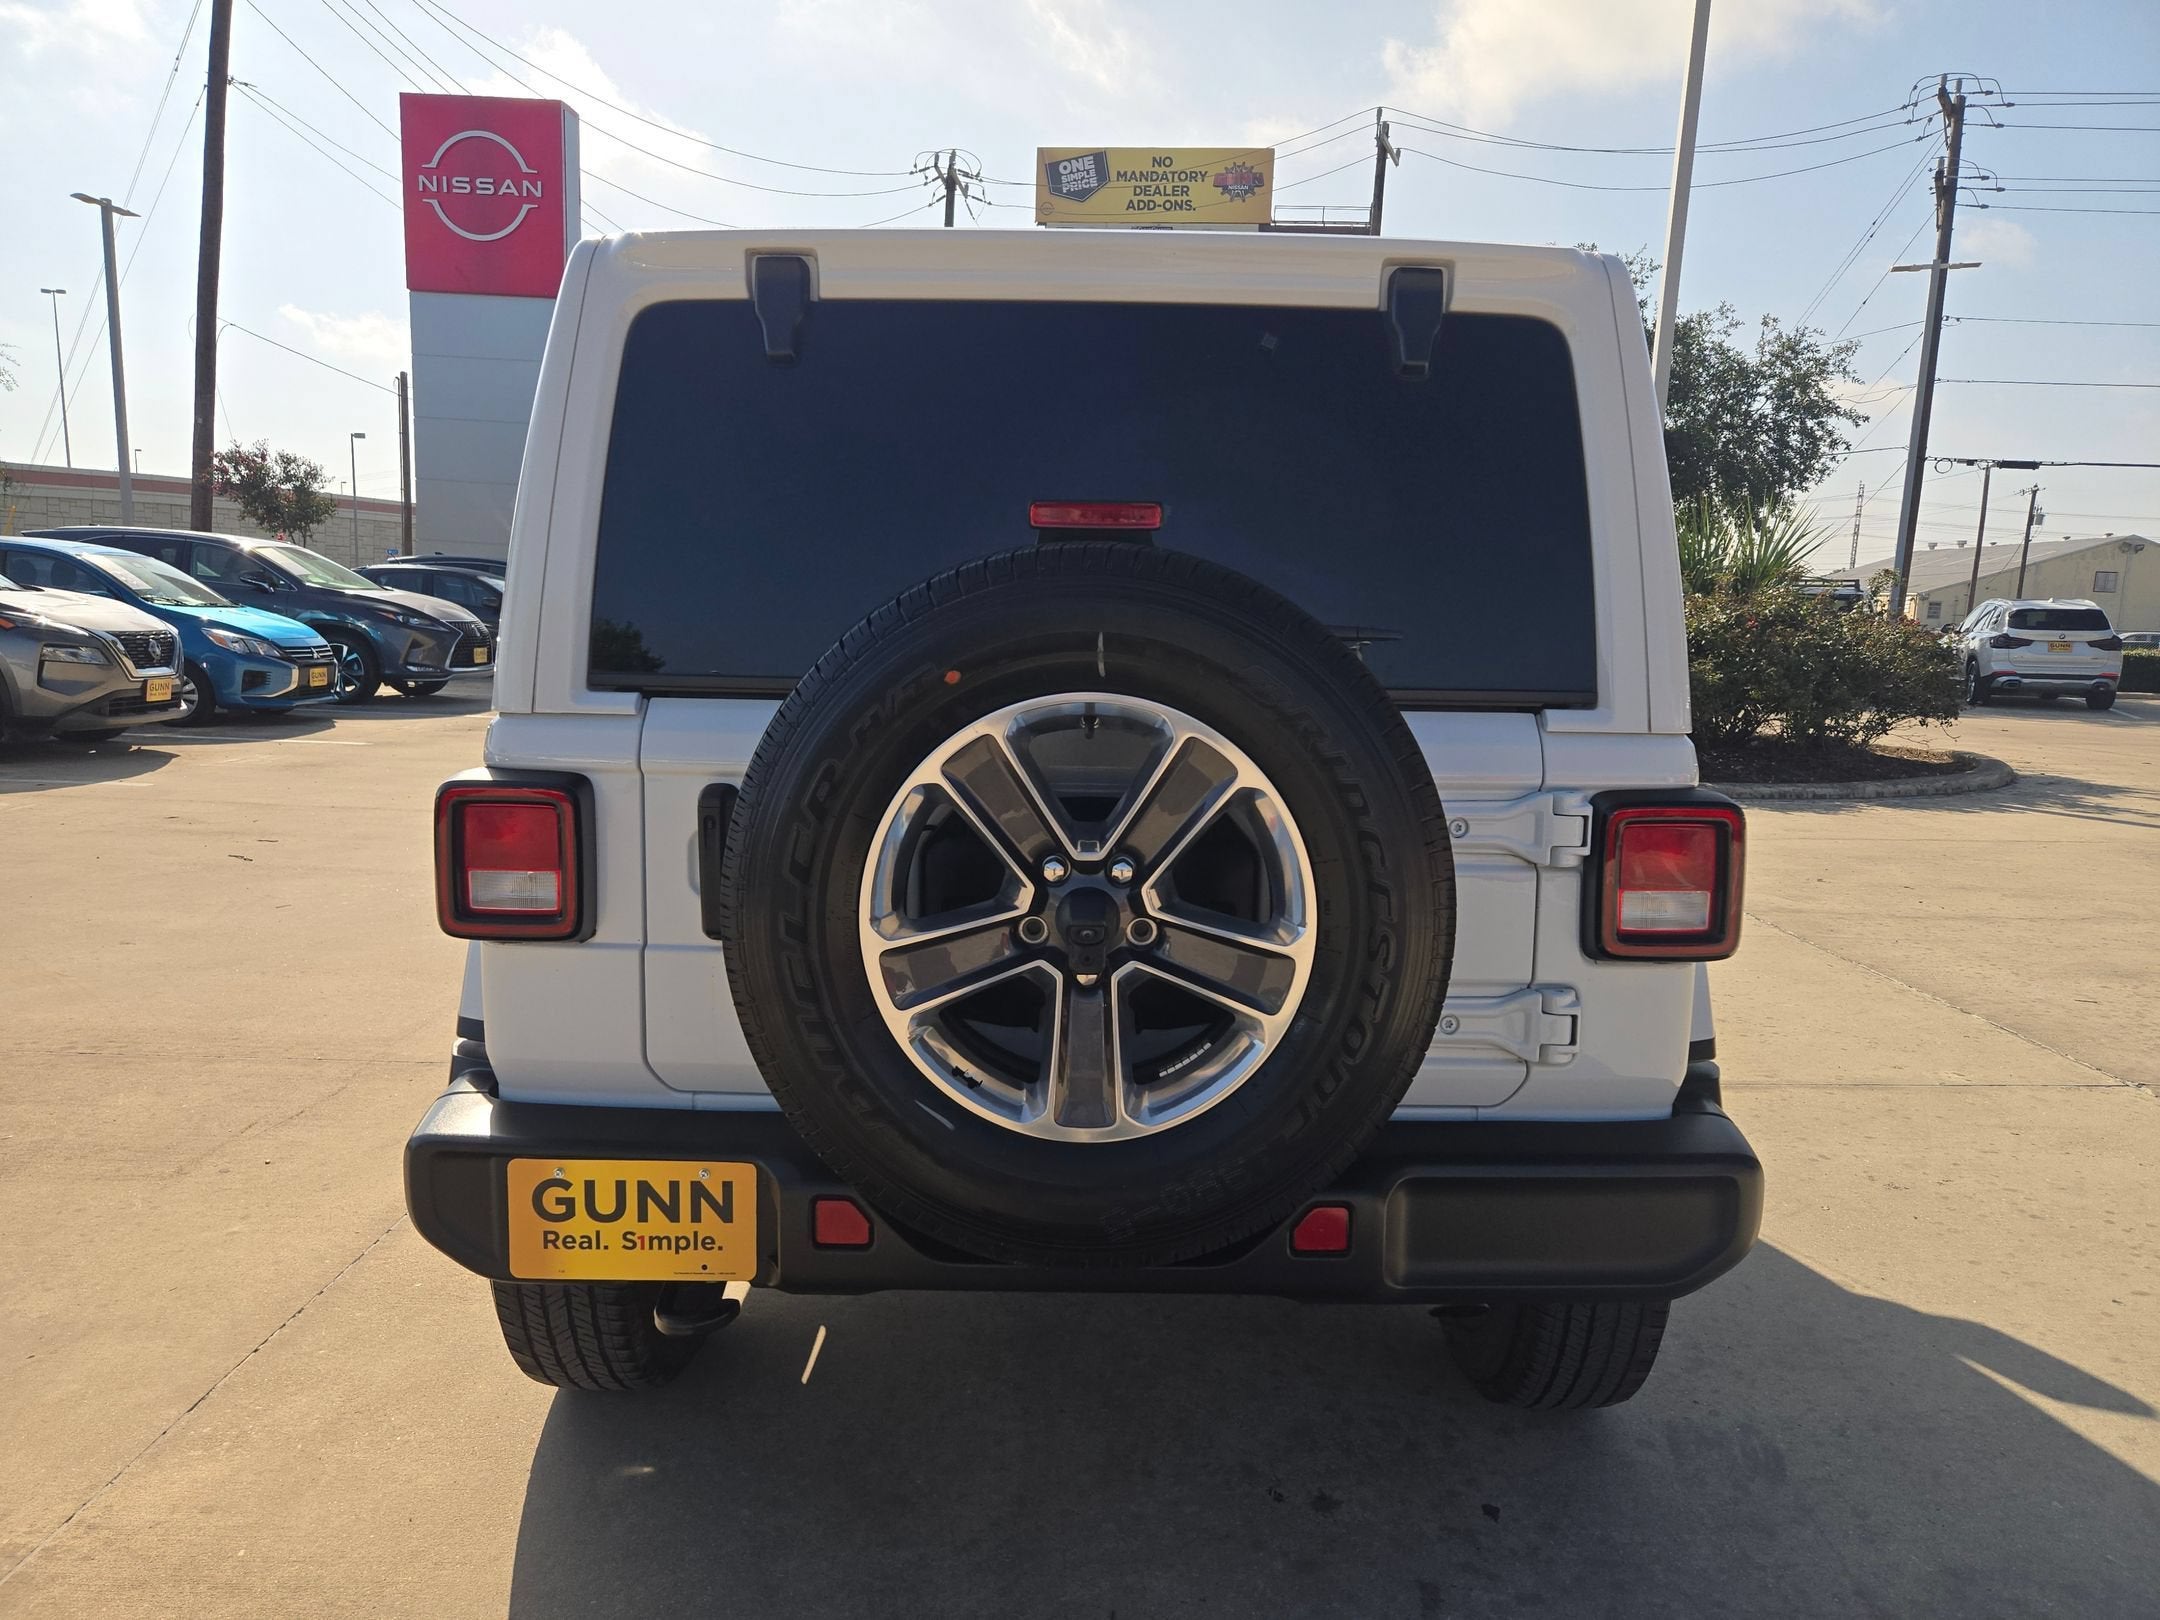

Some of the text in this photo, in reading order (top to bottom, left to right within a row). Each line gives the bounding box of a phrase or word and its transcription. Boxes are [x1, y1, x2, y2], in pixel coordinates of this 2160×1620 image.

[1059, 156, 1095, 174] ONE
[1152, 156, 1173, 168] NO
[1061, 169, 1096, 183] SIMPLE
[1116, 170, 1208, 182] MANDATORY
[418, 174, 542, 198] NISSAN
[1062, 177, 1098, 193] PRICE
[1133, 185, 1190, 197] DEALER
[1126, 199, 1196, 211] ADD-ONS.
[149, 682, 170, 692] GUNN
[531, 1178, 734, 1224] GUNN
[543, 1230, 609, 1250] Real.
